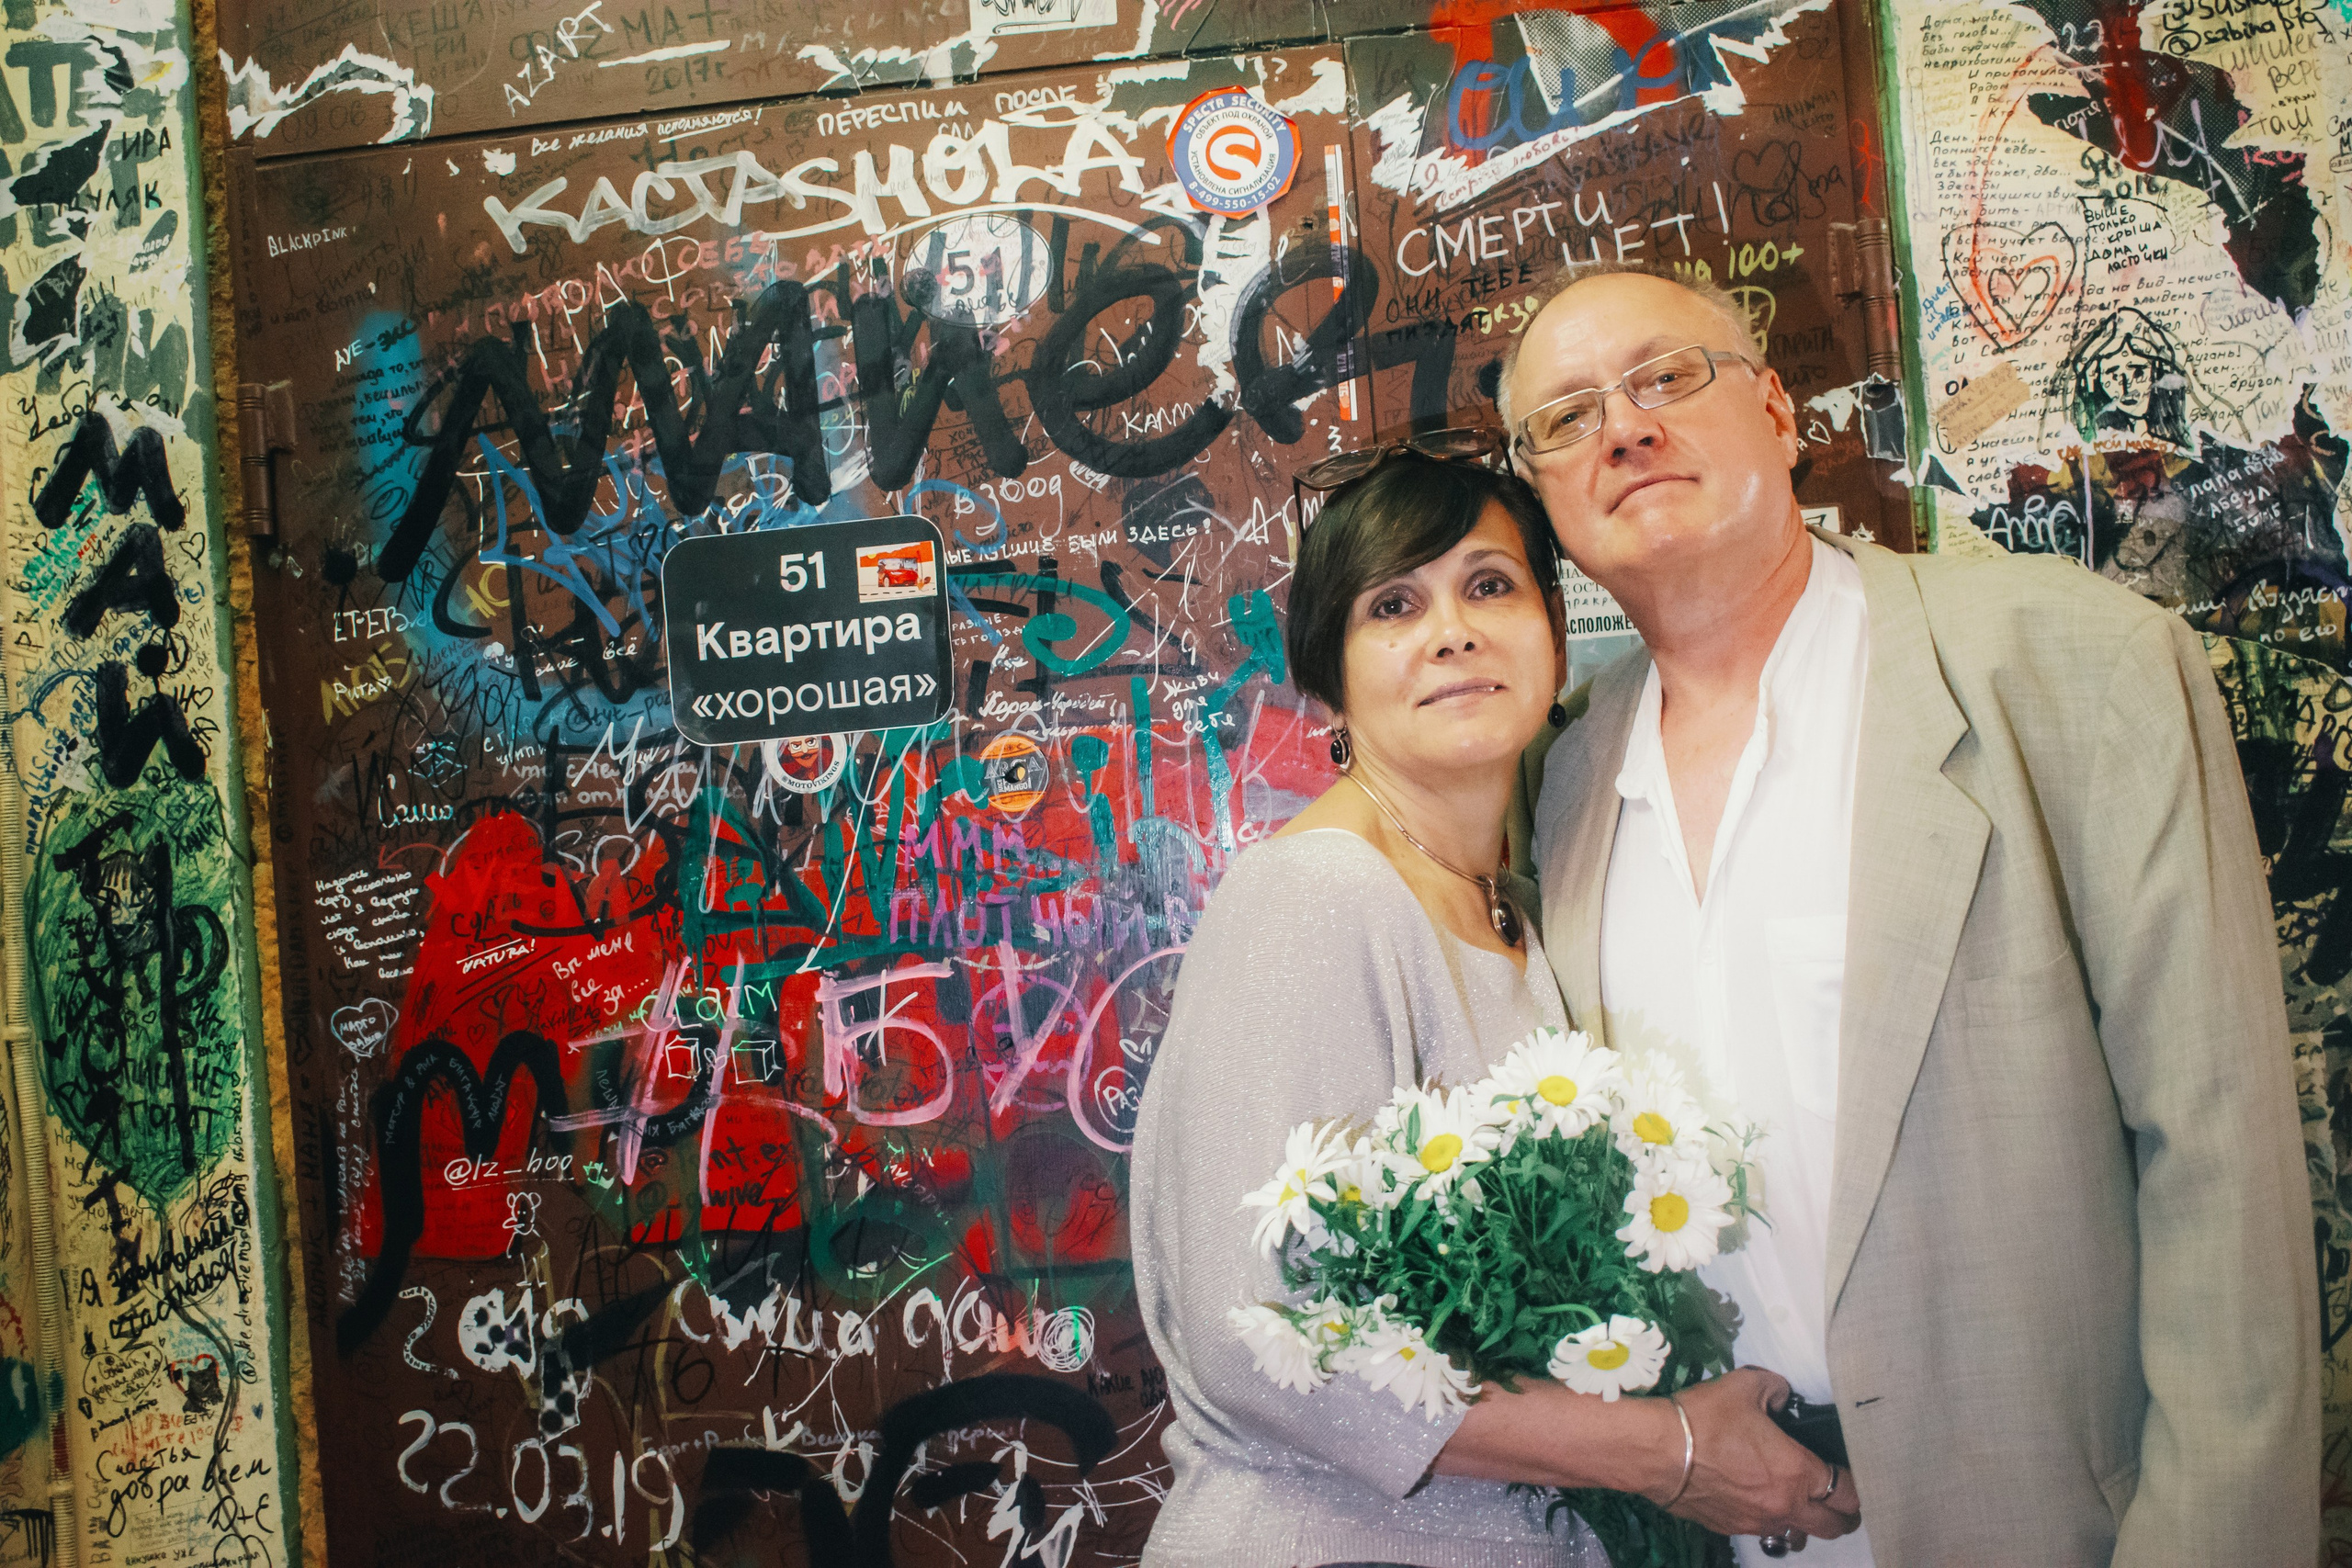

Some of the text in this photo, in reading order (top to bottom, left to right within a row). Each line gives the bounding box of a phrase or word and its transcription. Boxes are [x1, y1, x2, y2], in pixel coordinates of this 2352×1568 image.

[816, 97, 968, 137] ПЕРЕСПИМ
[1182, 95, 1287, 133] SPECTR SECURITY
[1195, 110, 1273, 141] ОБЪЕКТ ПОД ОХРАНОЙ
[121, 127, 172, 162] ИРА
[1191, 150, 1276, 196] УСТАНОВЛЕНА СИГНАЛИЗАЦИЯ
[1188, 175, 1282, 209] 8-499-550-15-02
[2083, 204, 2130, 224] ВЫШЕ
[2090, 213, 2137, 235] ТОЛЬКО
[2107, 220, 2163, 244] КРЫША
[266, 227, 348, 258] BLACKPINK
[1396, 190, 1614, 276] СМЕРТИ
[947, 246, 1004, 297] 51
[2086, 244, 2136, 263] ДОМА
[781, 551, 827, 592] 51
[696, 612, 922, 663] Квартира
[692, 673, 938, 726] «хорошая»
